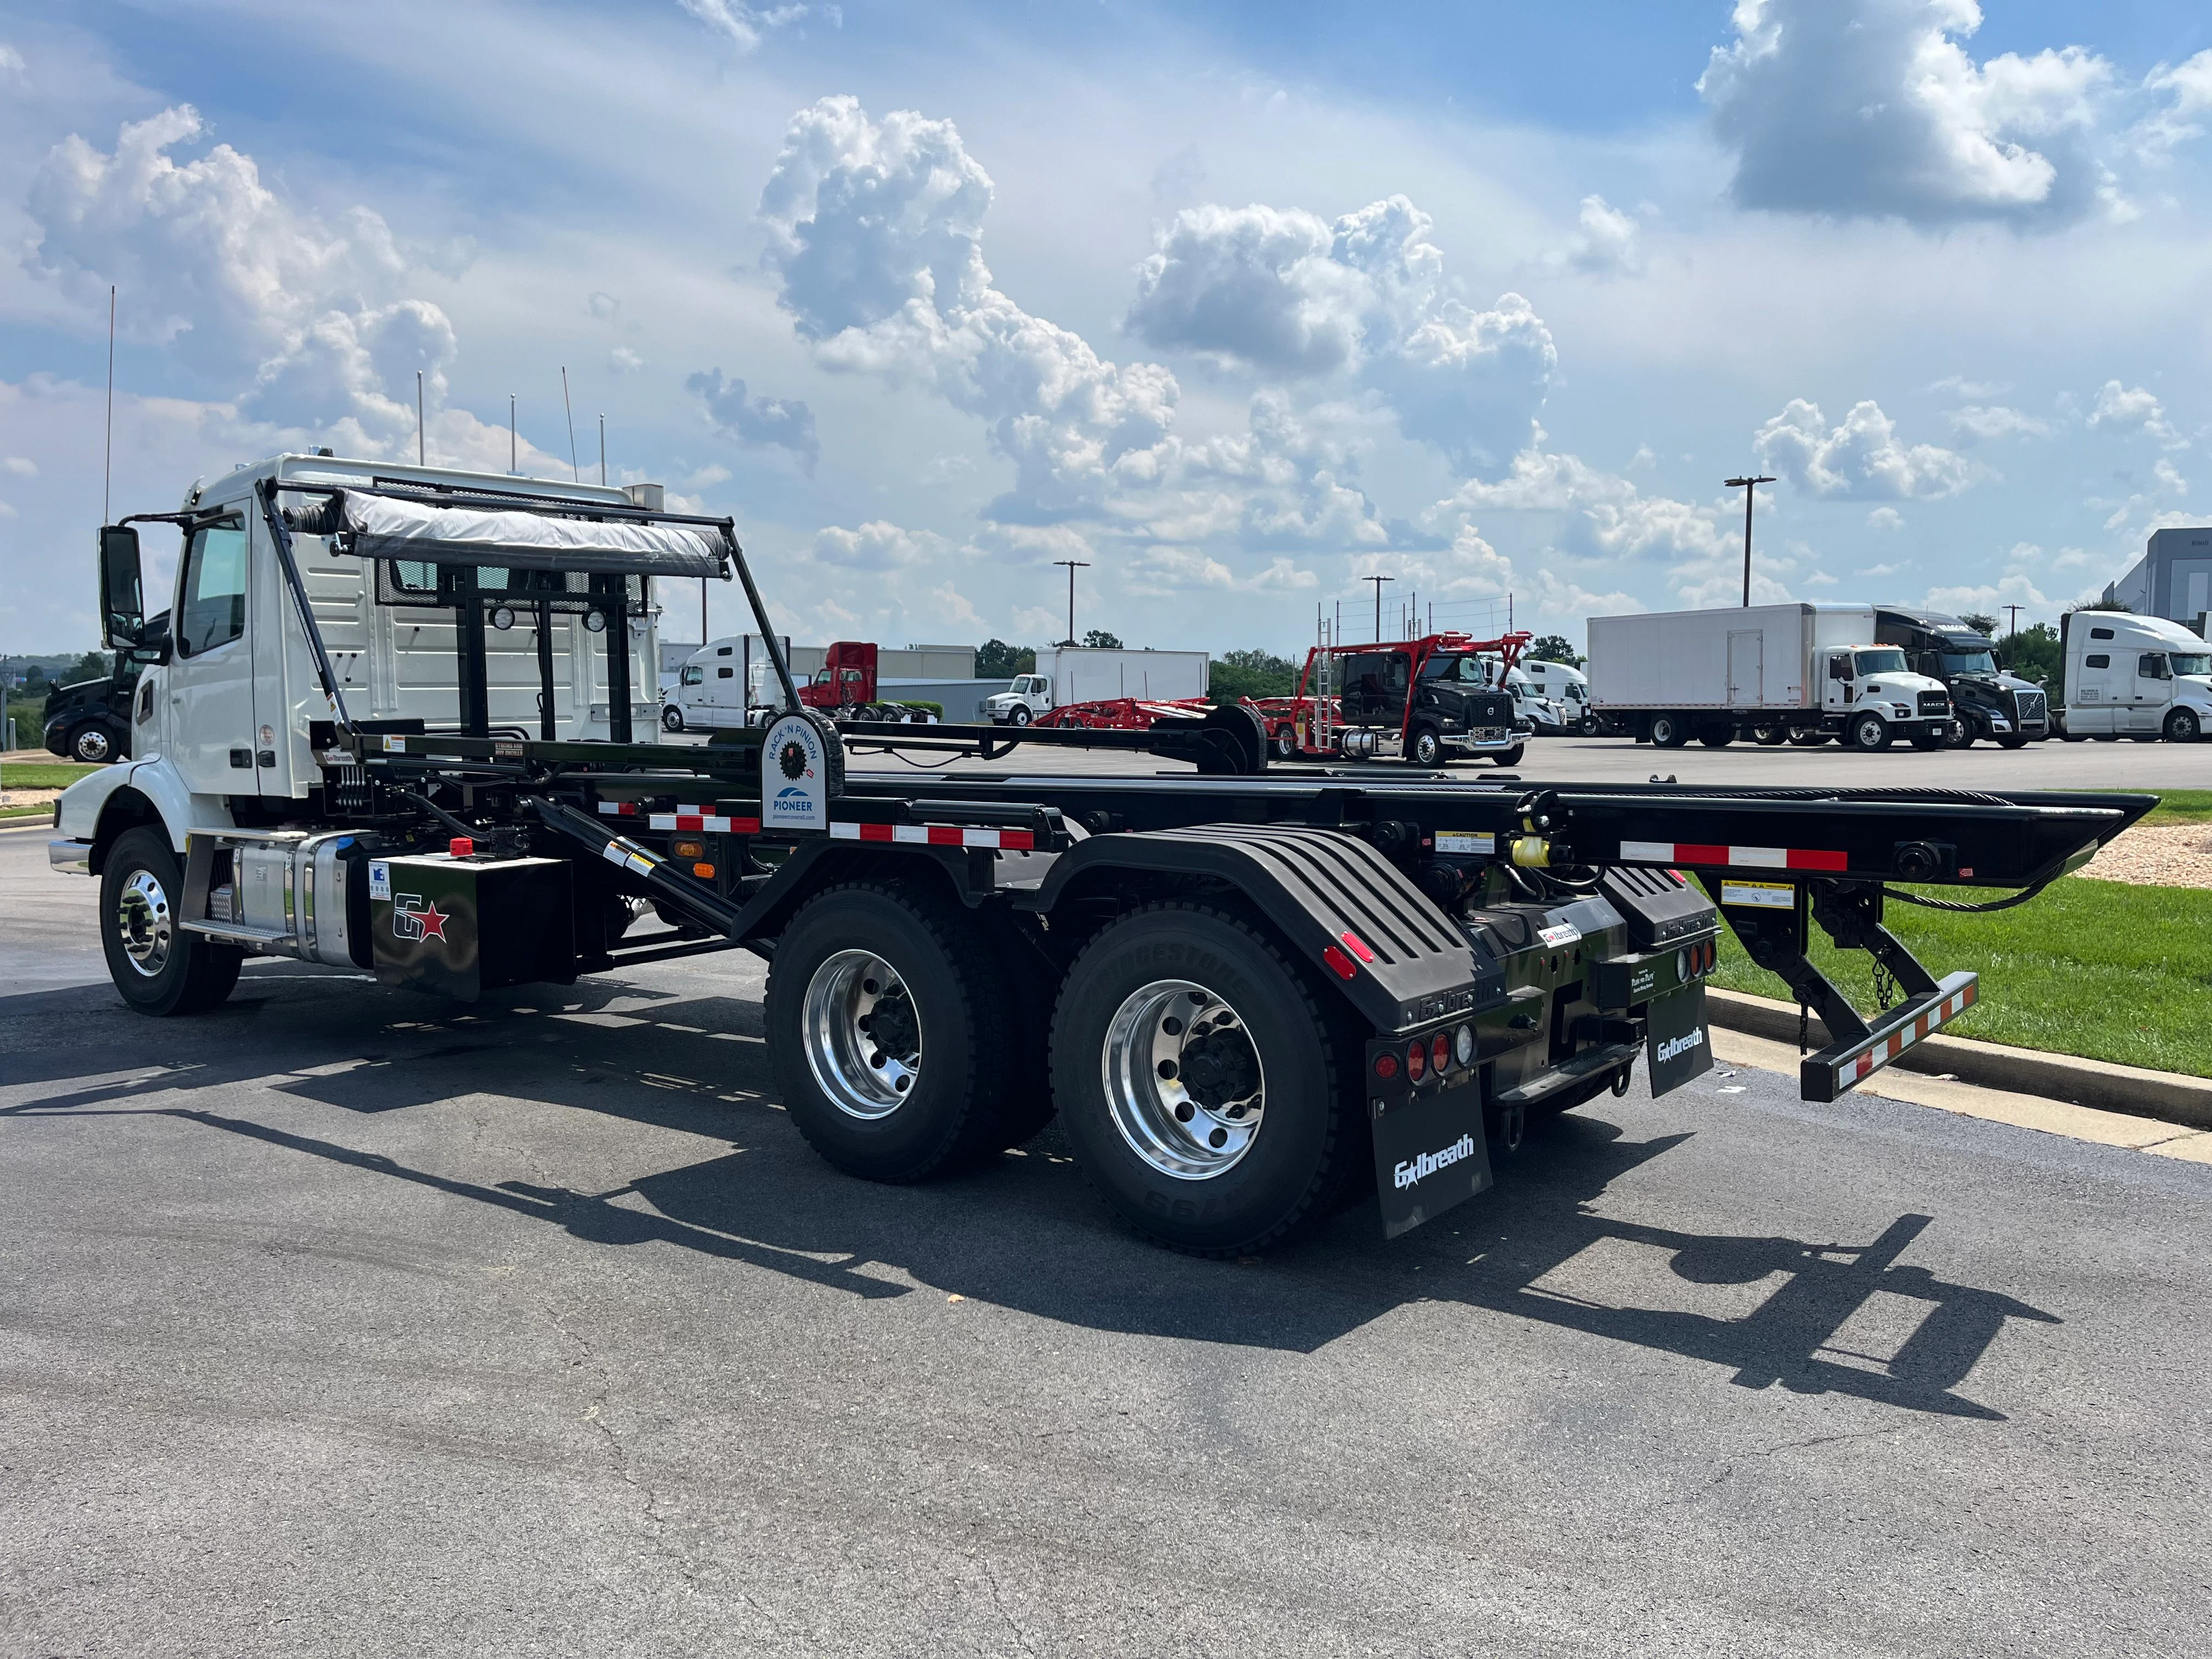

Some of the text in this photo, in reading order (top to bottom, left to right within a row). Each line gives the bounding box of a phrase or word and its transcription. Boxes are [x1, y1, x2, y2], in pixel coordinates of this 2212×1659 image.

[769, 728, 785, 760] RACK
[795, 725, 817, 759] PINION
[774, 800, 812, 811] PIONEER
